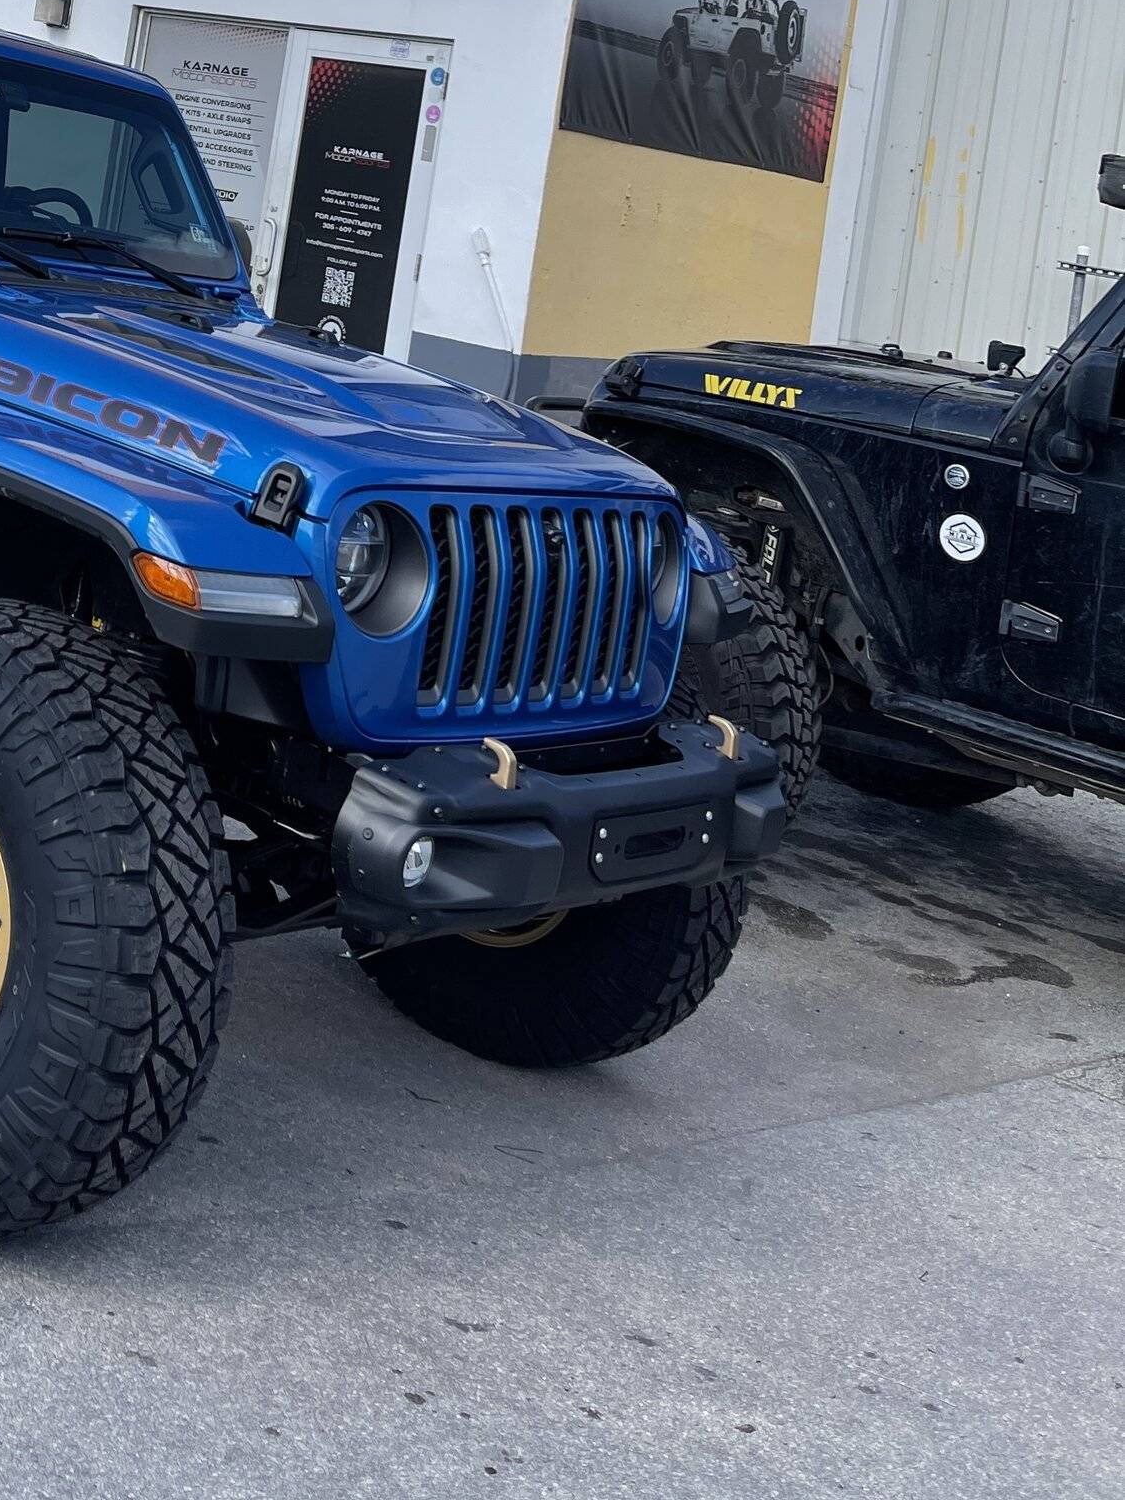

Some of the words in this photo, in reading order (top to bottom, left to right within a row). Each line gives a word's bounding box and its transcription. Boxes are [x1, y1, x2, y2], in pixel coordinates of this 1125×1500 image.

[183, 60, 249, 77] KARNAGE
[175, 93, 200, 104] ENGINE
[202, 97, 252, 111] CONVERSIONS
[185, 108, 201, 118] KITS
[207, 111, 225, 121] AXLE
[226, 115, 252, 125] SWAPS
[213, 127, 252, 140] UPGRADES
[205, 142, 254, 156] ACCESSORIES
[333, 145, 384, 160] KARNAGE
[217, 160, 252, 172] STEERING
[216, 189, 236, 200] DIO
[315, 212, 329, 220] FOR
[329, 215, 382, 230] APPOINTMENTS
[322, 222, 335, 230] 305
